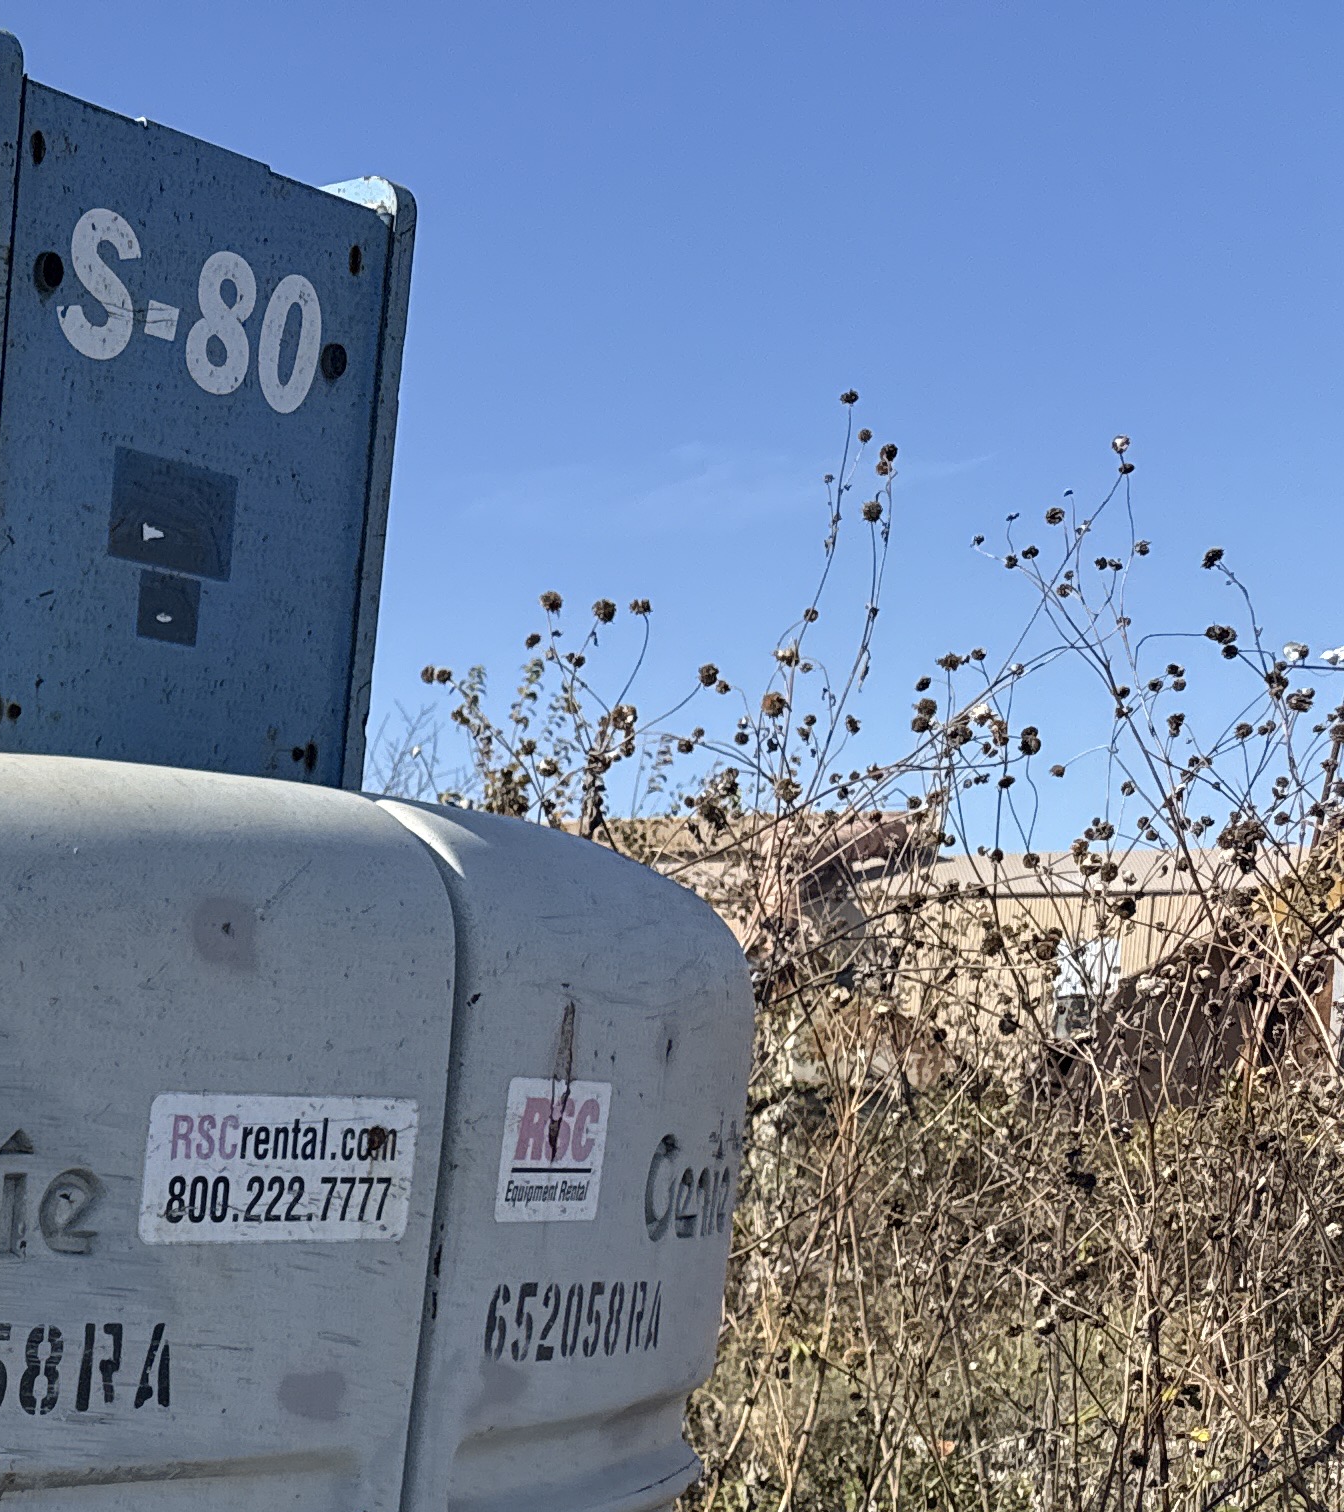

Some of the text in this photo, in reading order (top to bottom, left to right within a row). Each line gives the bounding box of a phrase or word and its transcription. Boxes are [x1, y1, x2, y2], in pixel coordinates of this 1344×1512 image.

[56, 207, 322, 414] S-80
[170, 1113, 398, 1161] RSCrental.com
[513, 1097, 601, 1162] RSC
[165, 1175, 392, 1224] 800.222.7777
[505, 1179, 591, 1207] Equipment Rental
[644, 1132, 732, 1242] Genie
[485, 1280, 662, 1362] 652058RA
